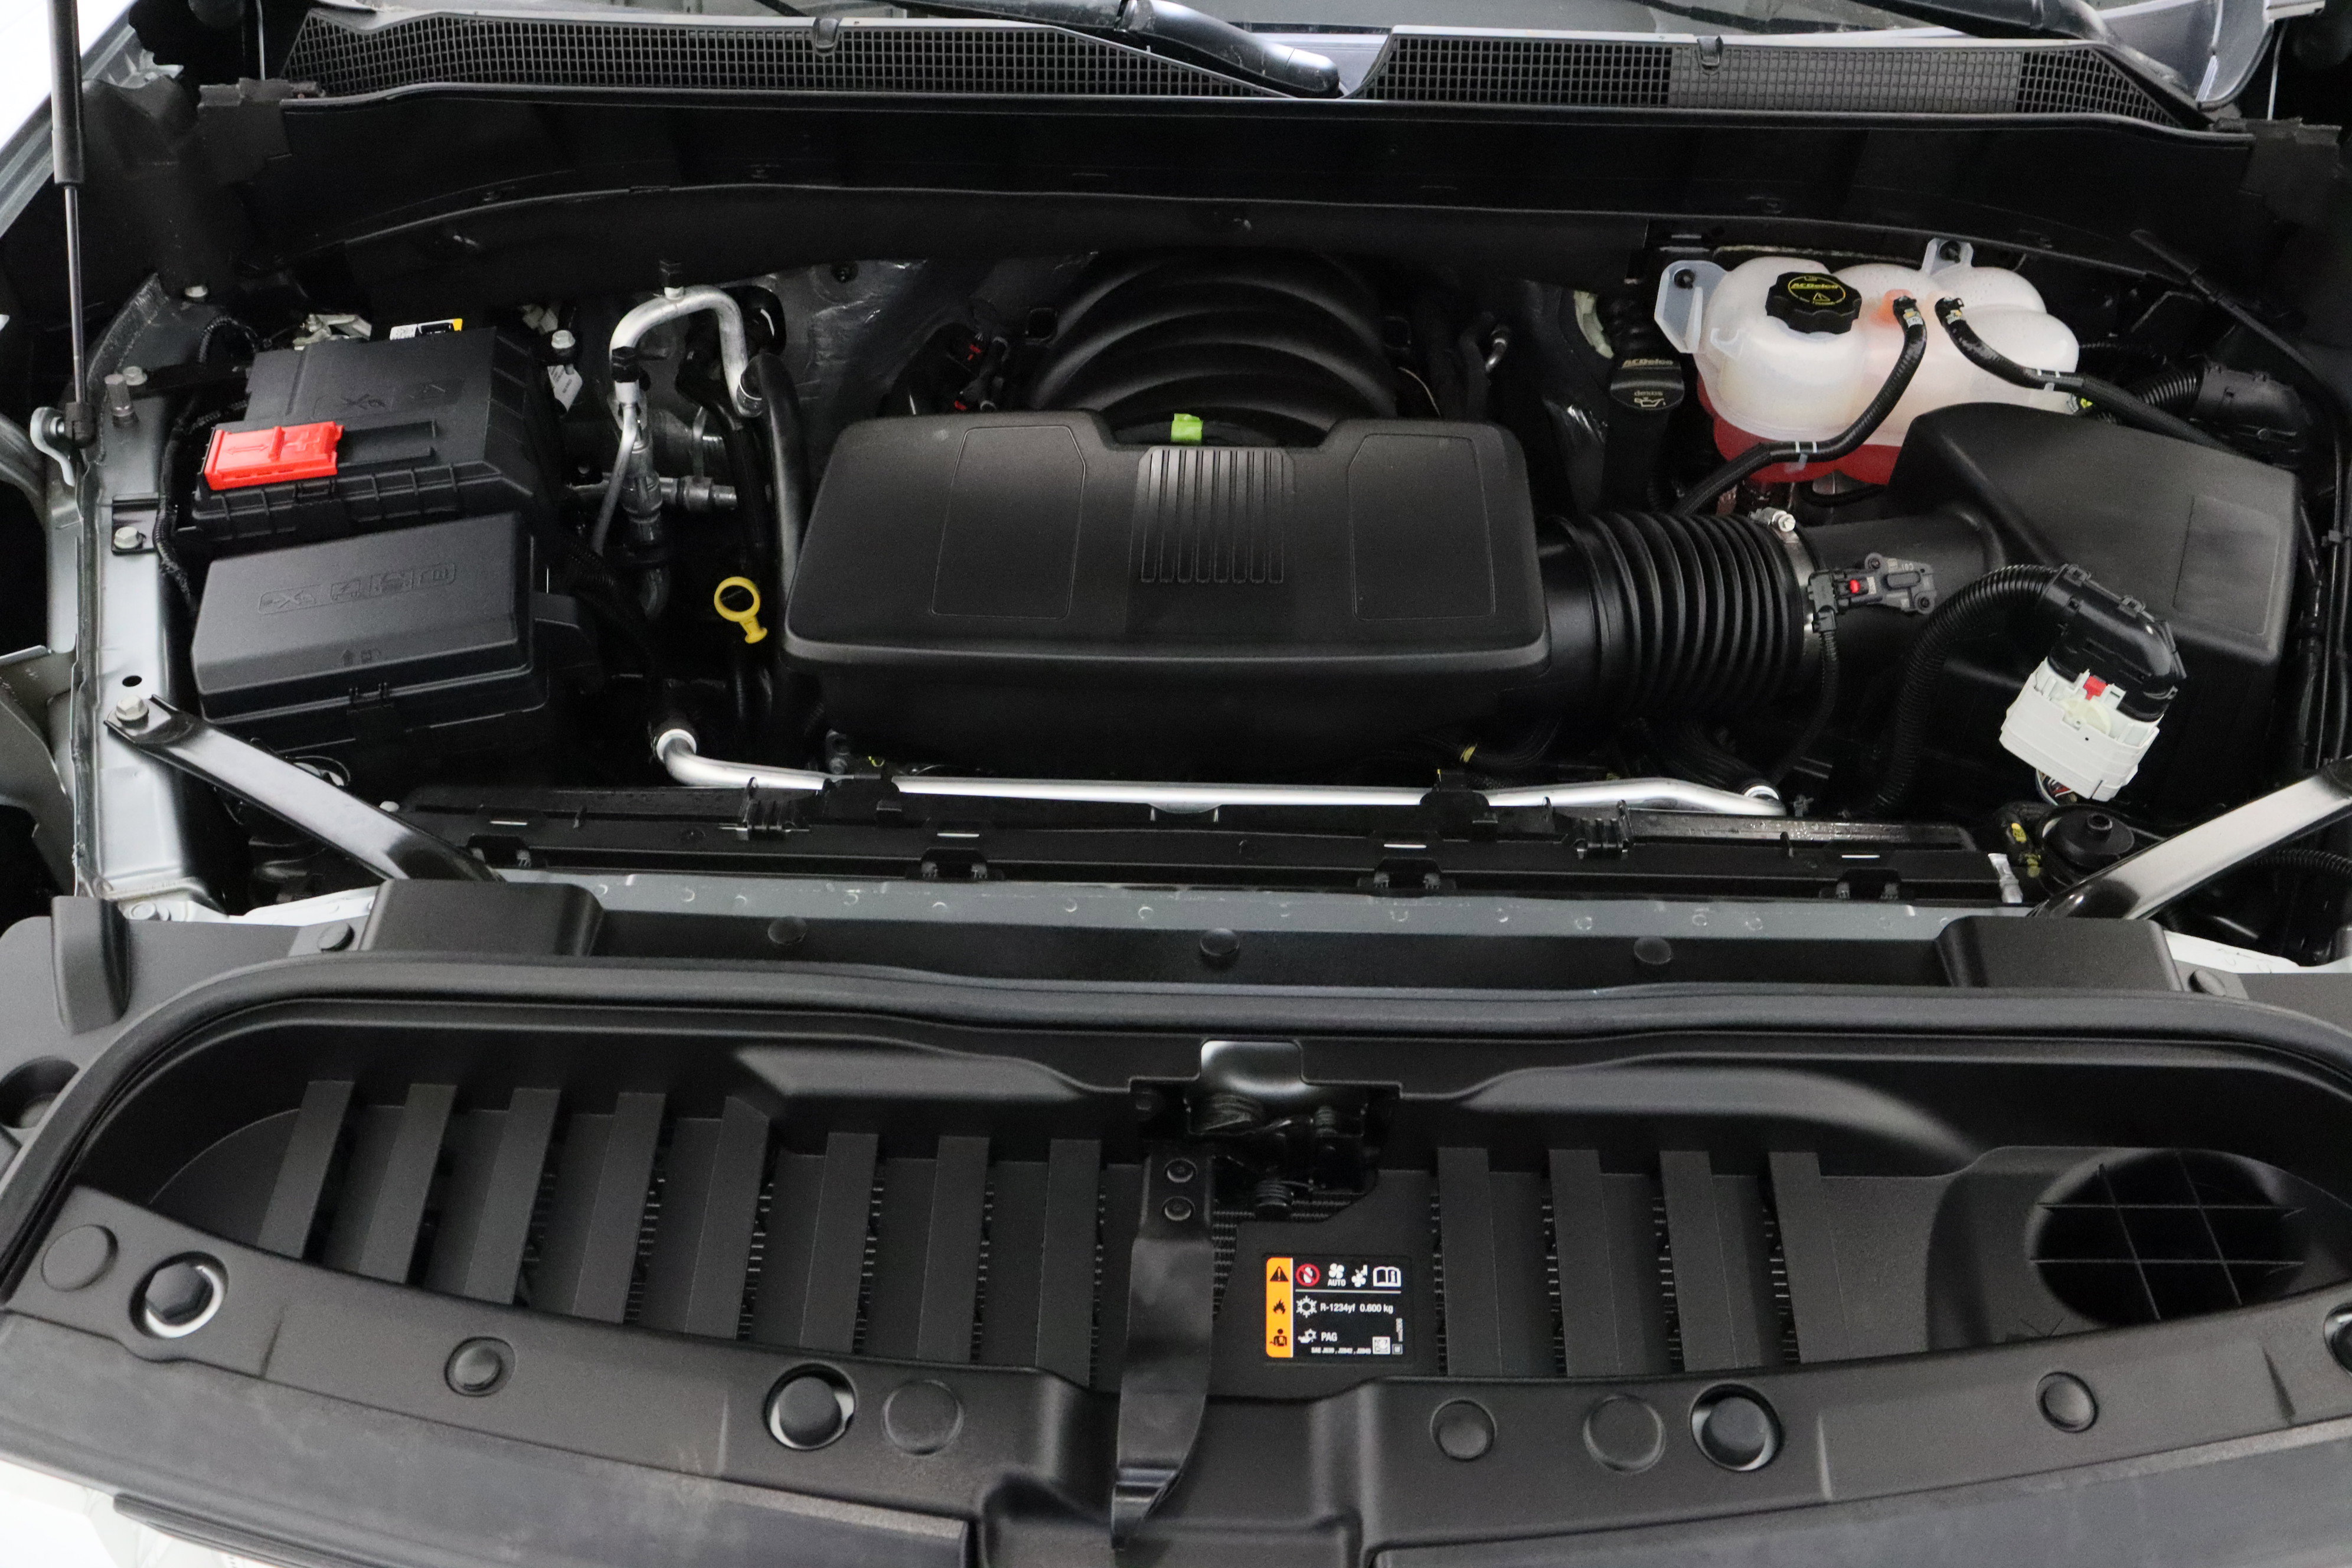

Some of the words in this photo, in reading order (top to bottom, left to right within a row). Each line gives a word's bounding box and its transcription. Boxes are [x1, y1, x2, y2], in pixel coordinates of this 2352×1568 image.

[1622, 359, 1674, 368] ACDelco
[1320, 1302, 1355, 1314] R-1234yf
[1383, 1304, 1393, 1314] kg
[1321, 1332, 1338, 1342] PAG
